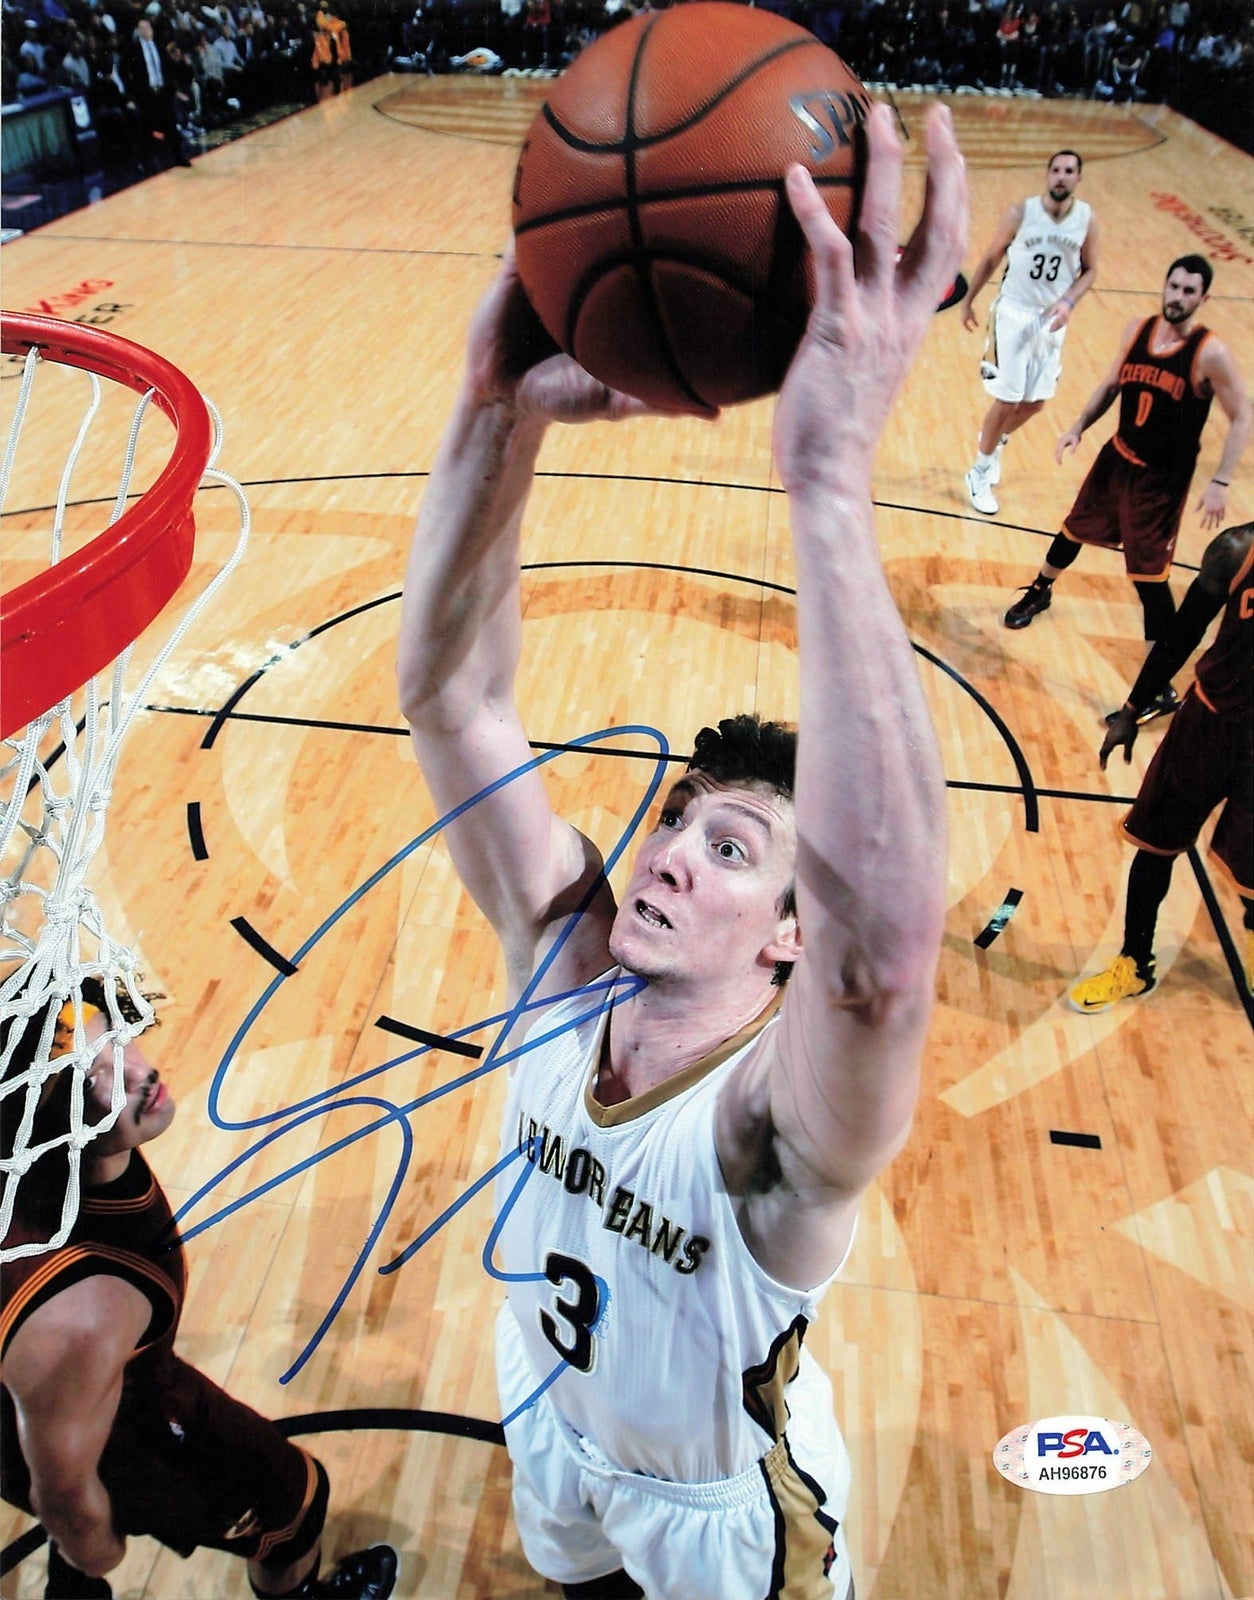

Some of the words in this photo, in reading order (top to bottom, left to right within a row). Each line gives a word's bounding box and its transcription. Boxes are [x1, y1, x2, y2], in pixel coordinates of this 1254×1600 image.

[1029, 253, 1062, 282] 33
[539, 1251, 600, 1375] 3
[1038, 1465, 1107, 1481] AH96876
